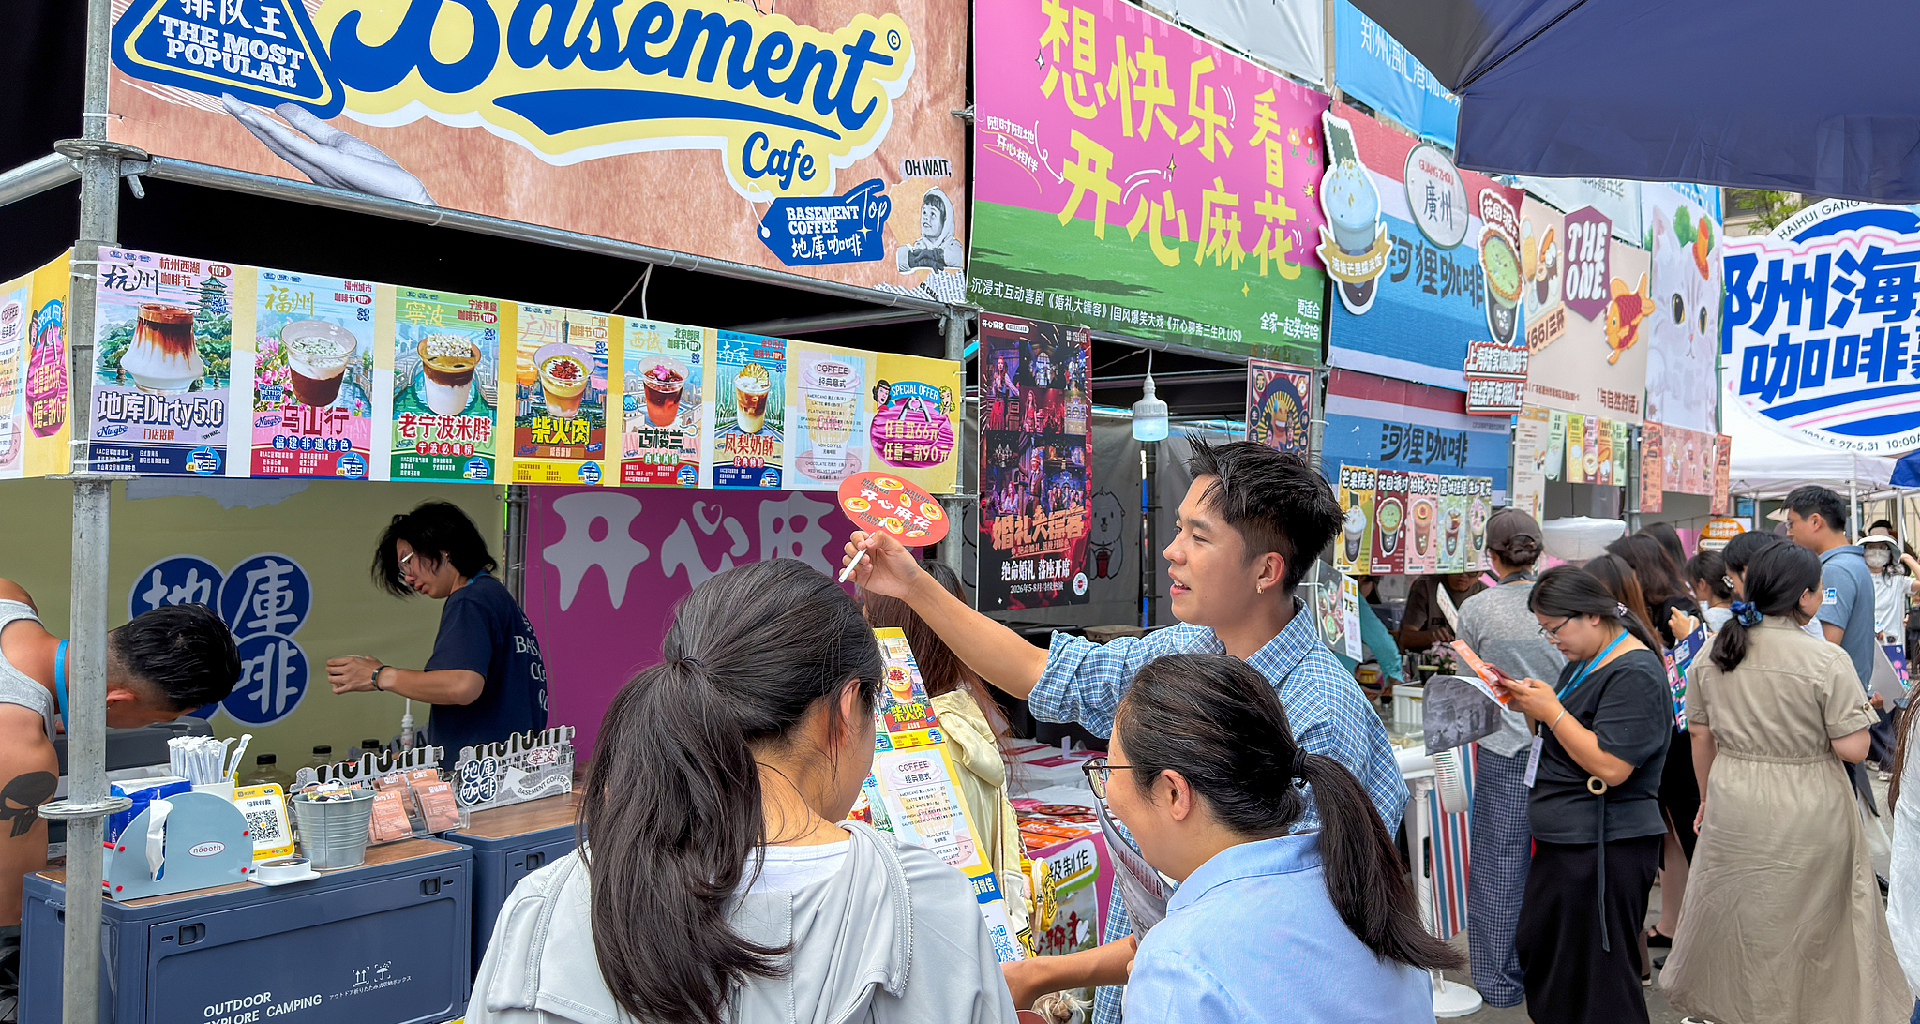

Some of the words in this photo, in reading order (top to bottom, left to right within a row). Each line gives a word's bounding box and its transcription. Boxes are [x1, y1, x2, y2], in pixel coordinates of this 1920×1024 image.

[158, 14, 220, 46] THE
[222, 32, 304, 72] MOST
[166, 37, 297, 89] POPULAR
[986, 115, 1035, 146] 随时随地
[742, 131, 817, 190] Cafe
[996, 133, 1040, 174] 开心相伴
[905, 159, 920, 176] OH
[922, 160, 952, 178] WAIT,
[786, 206, 860, 223] BASEMENT
[1058, 129, 1301, 280] 开心麻花
[1423, 180, 1454, 231] 廣州
[788, 220, 838, 235] COFFEE
[1778, 209, 1819, 240] HAIHUI
[791, 234, 862, 261] 地庫咖啡
[1567, 220, 1609, 264] THE
[101, 264, 159, 296] 杭州
[159, 257, 201, 275] 杭州西湖
[160, 272, 191, 287] 咖啡节
[211, 265, 227, 277] TOP1
[1388, 233, 1484, 311] 河狸咖啡
[1566, 262, 1608, 301] ONE.
[264, 284, 314, 317] 福州
[1297, 297, 1321, 320] 更适合
[521, 314, 559, 343] 广州
[592, 316, 606, 327] 广州
[1260, 311, 1320, 340] 全家一起笑哈哈
[816, 364, 849, 375] COFFEE
[1739, 324, 1920, 404] 咖啡
[891, 384, 918, 397] SPECIAL
[918, 384, 939, 400] OFFER
[397, 413, 491, 442] 老宁波米胖
[531, 416, 592, 446] 柴火肉
[638, 427, 684, 450] 古楼兰
[275, 435, 350, 452] 福建非遗特色
[724, 432, 774, 457] 凤梨奶酥
[1380, 423, 1469, 469] 河狸咖啡
[1341, 469, 1375, 491] 芒果糯米
[860, 488, 932, 530] 开心麻花
[992, 502, 1088, 551] 婚礼大镖客
[1001, 559, 1036, 581] 绝命婚礼
[1038, 557, 1071, 580] 落座开席
[891, 702, 927, 723] 柴火肉
[463, 758, 496, 780] 地庫
[898, 760, 930, 773] COFFEE
[462, 779, 495, 800] 咖啡
[203, 991, 271, 1018] OUTDOOR
[266, 993, 323, 1017] CAMPING
